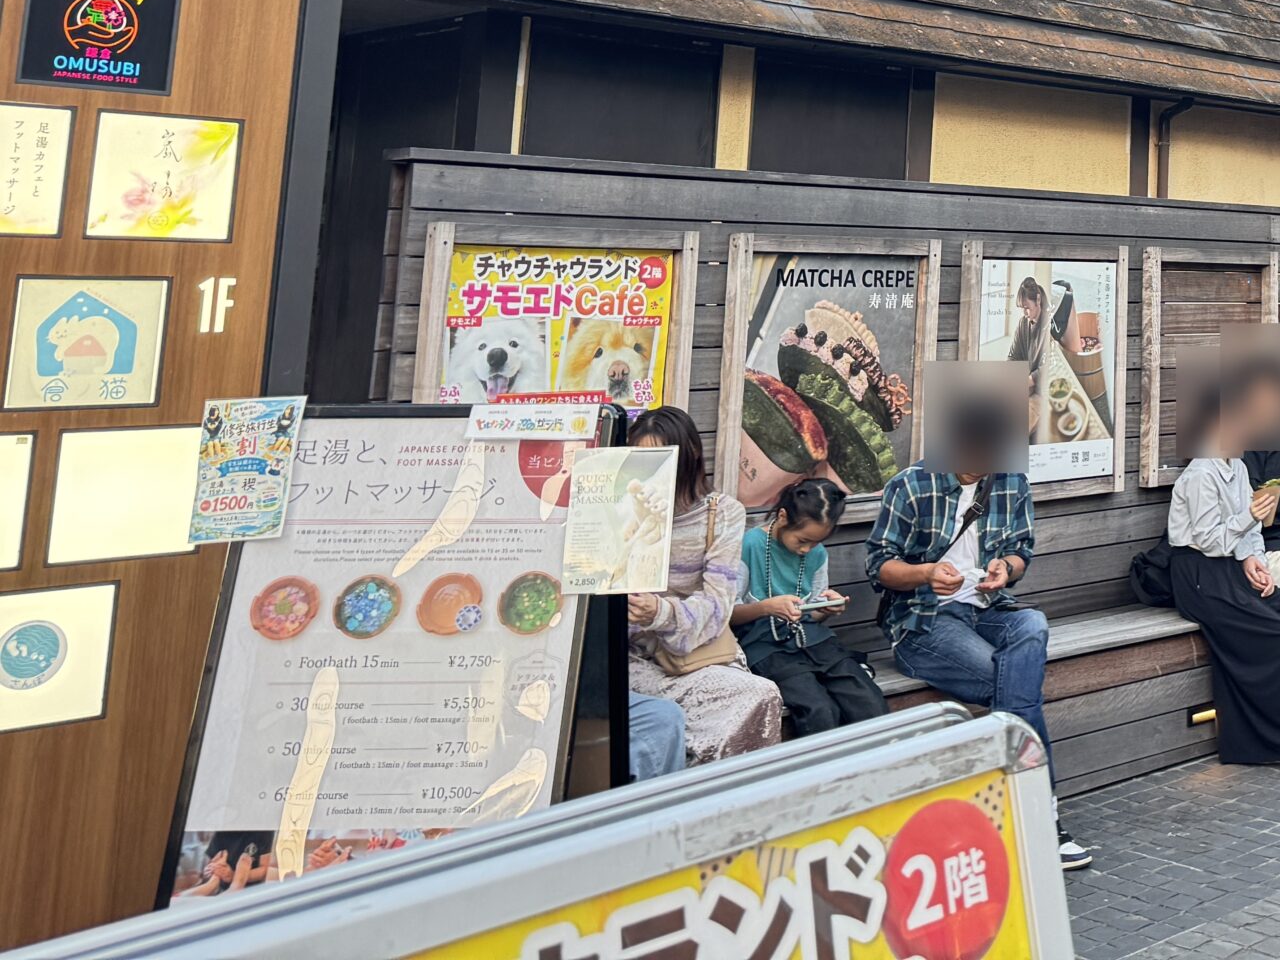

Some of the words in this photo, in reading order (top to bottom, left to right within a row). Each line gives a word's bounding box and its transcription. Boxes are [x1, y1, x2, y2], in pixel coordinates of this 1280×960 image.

[53, 55, 140, 76] OMUSUBI
[53, 71, 90, 80] JAPANESE
[92, 74, 114, 82] FOOD
[115, 76, 138, 84] STYLE
[4, 120, 25, 216] フットマッサージ
[32, 122, 50, 198] 足湯カフェと
[476, 256, 638, 280] チャウチャウランド
[641, 266, 663, 279] 2階
[776, 268, 857, 288] MATCHA
[862, 269, 915, 288] CREPE
[198, 277, 236, 333] 1F
[868, 293, 914, 309] 寿清庵
[450, 318, 478, 326] サモエド
[625, 317, 660, 326] チャウチャウ
[221, 420, 277, 439] 修学旅行生
[236, 437, 257, 456] 割
[399, 444, 447, 453] JAPANESE
[396, 458, 423, 467] FOOT
[299, 655, 357, 669] Footbath
[361, 654, 380, 669] 15
[380, 660, 400, 668] min
[290, 697, 309, 712] 30
[281, 741, 302, 756] 50
[316, 791, 349, 800] course
[902, 846, 990, 932] 2階
